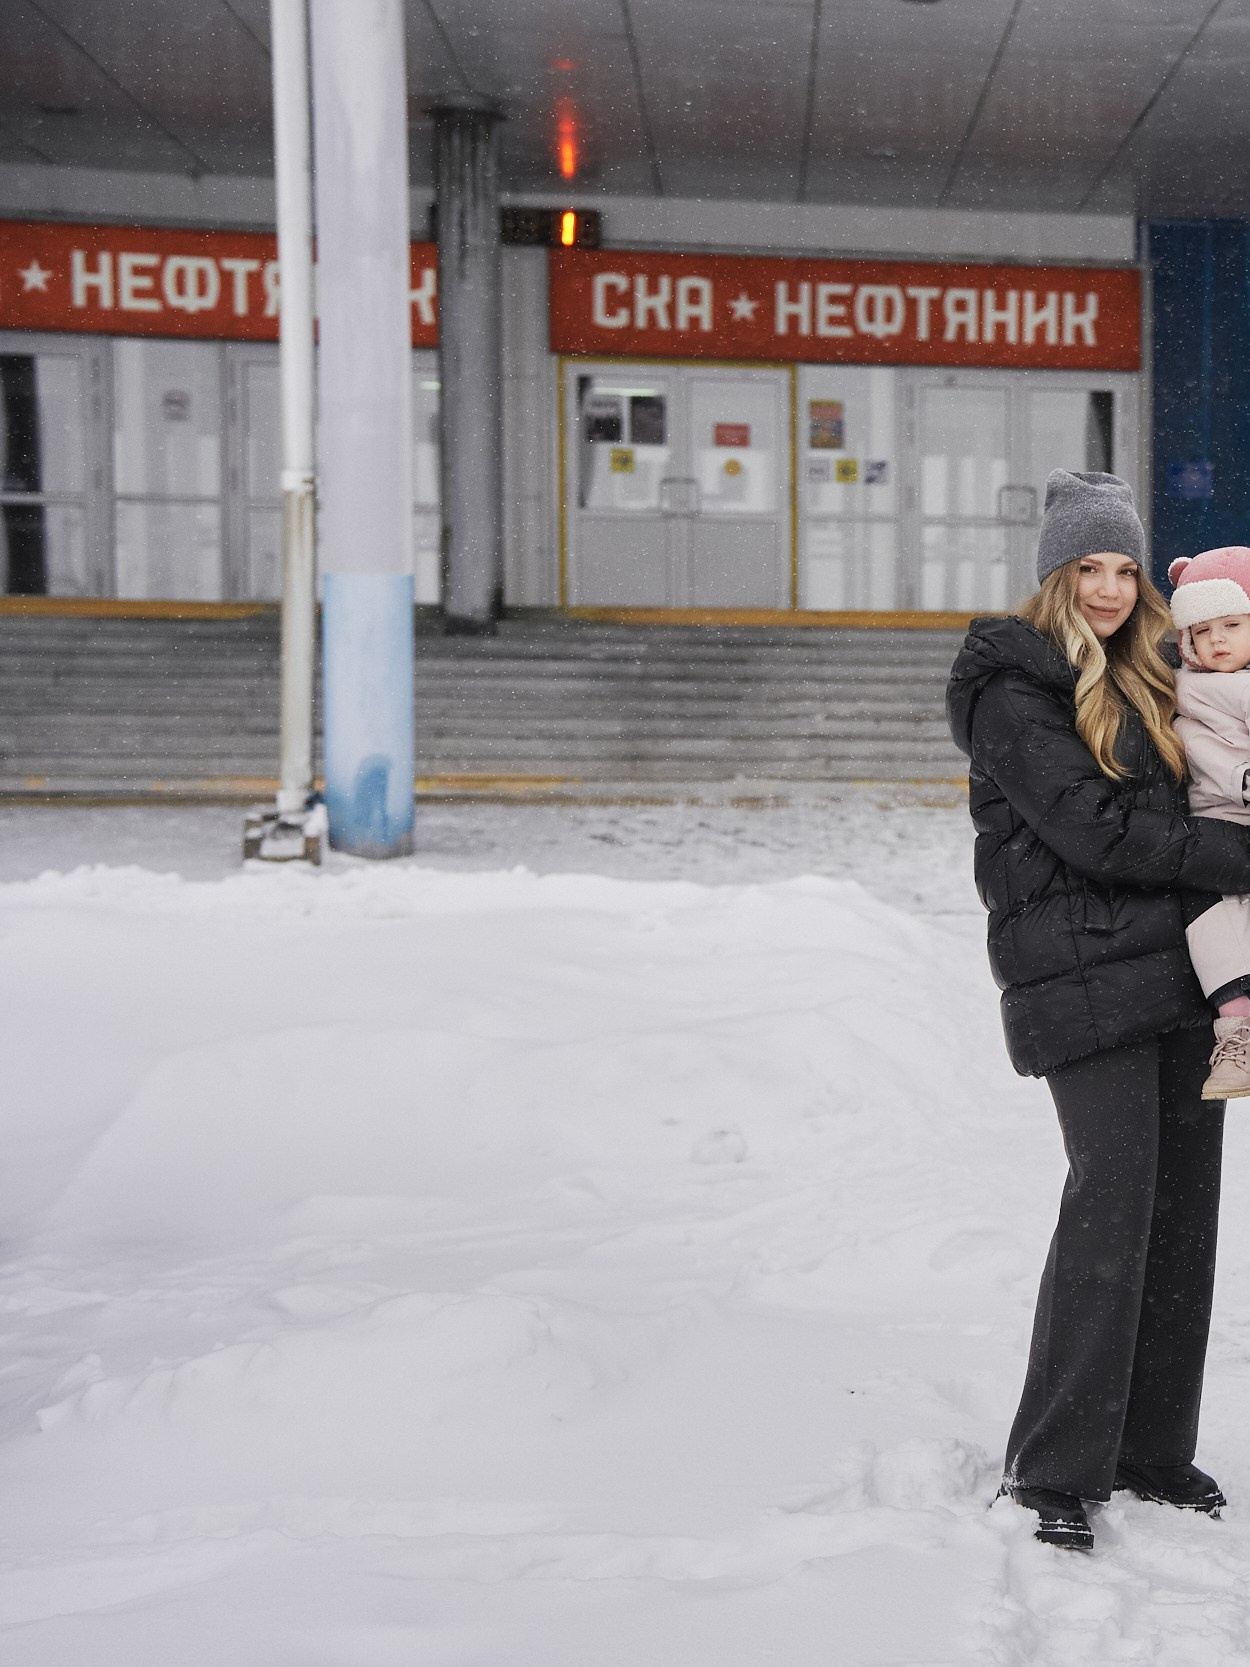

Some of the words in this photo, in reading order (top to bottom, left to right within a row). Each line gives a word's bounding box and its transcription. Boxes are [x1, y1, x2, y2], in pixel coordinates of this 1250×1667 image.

[72, 251, 436, 324] НЕФТЯК
[593, 273, 712, 331] СКА
[775, 282, 1098, 346] НЕФТЯНИК
